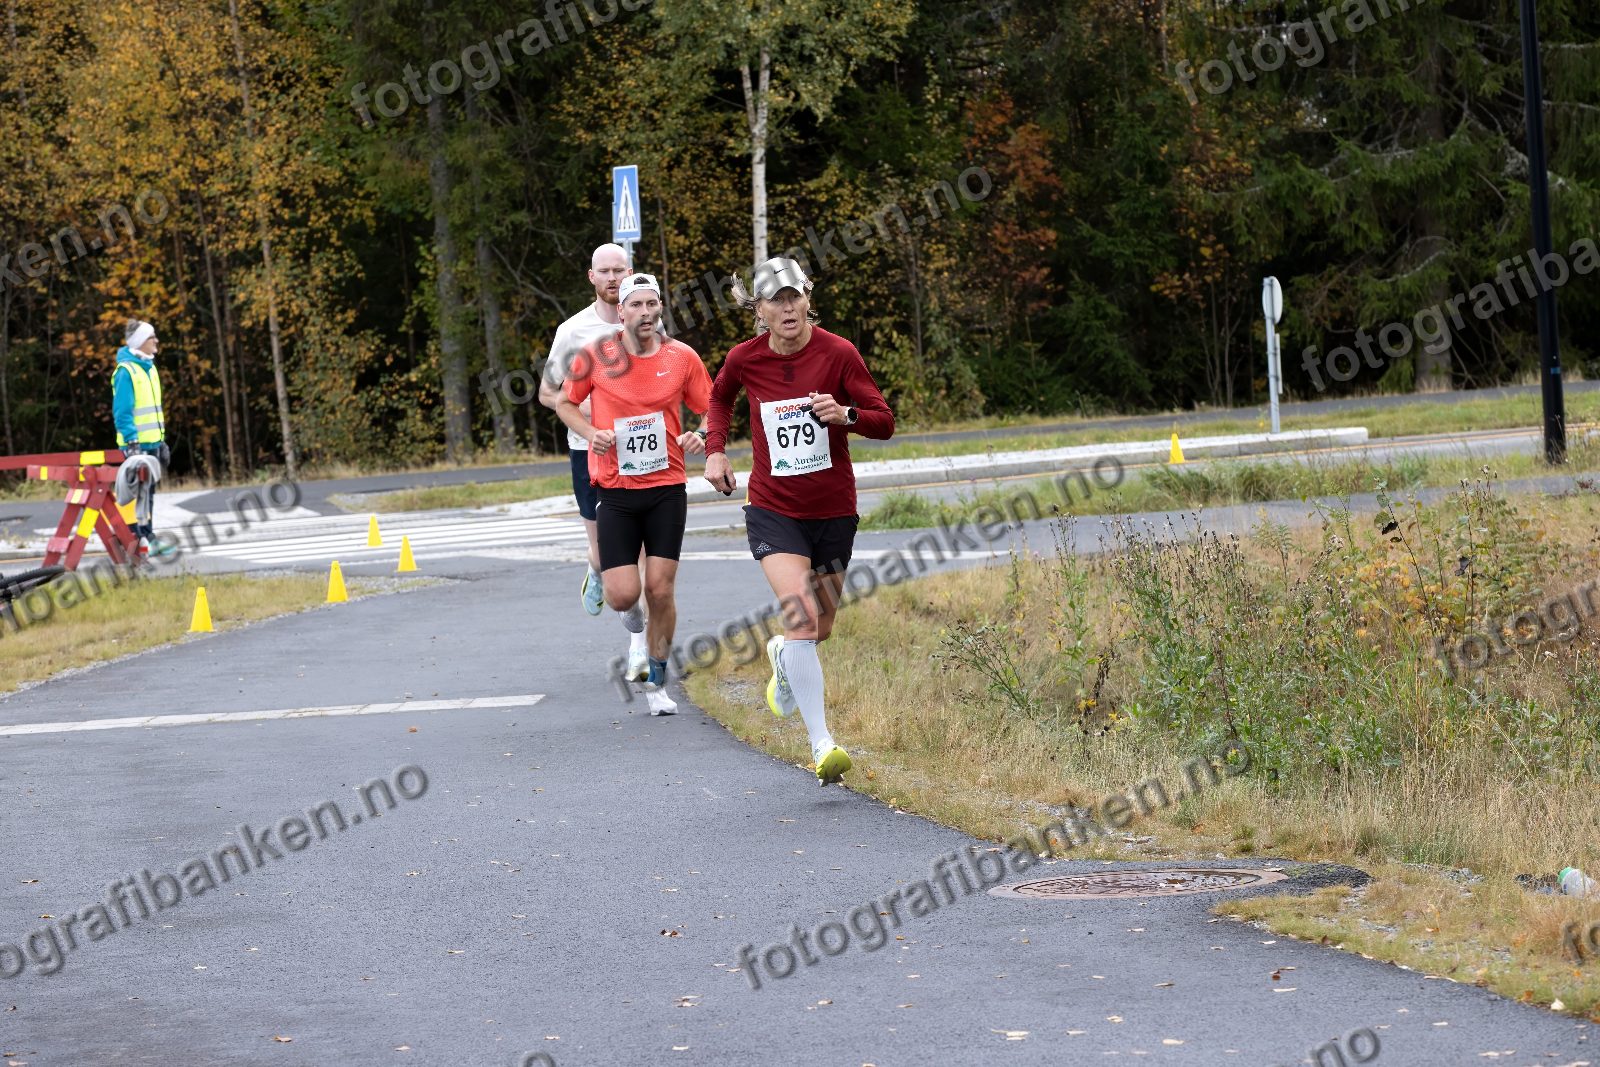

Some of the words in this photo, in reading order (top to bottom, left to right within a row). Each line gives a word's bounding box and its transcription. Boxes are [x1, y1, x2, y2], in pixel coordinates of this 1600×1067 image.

[779, 411, 806, 421] LØPET
[626, 433, 658, 454] 478
[776, 422, 816, 449] 679
[794, 453, 829, 466] Aurskog
